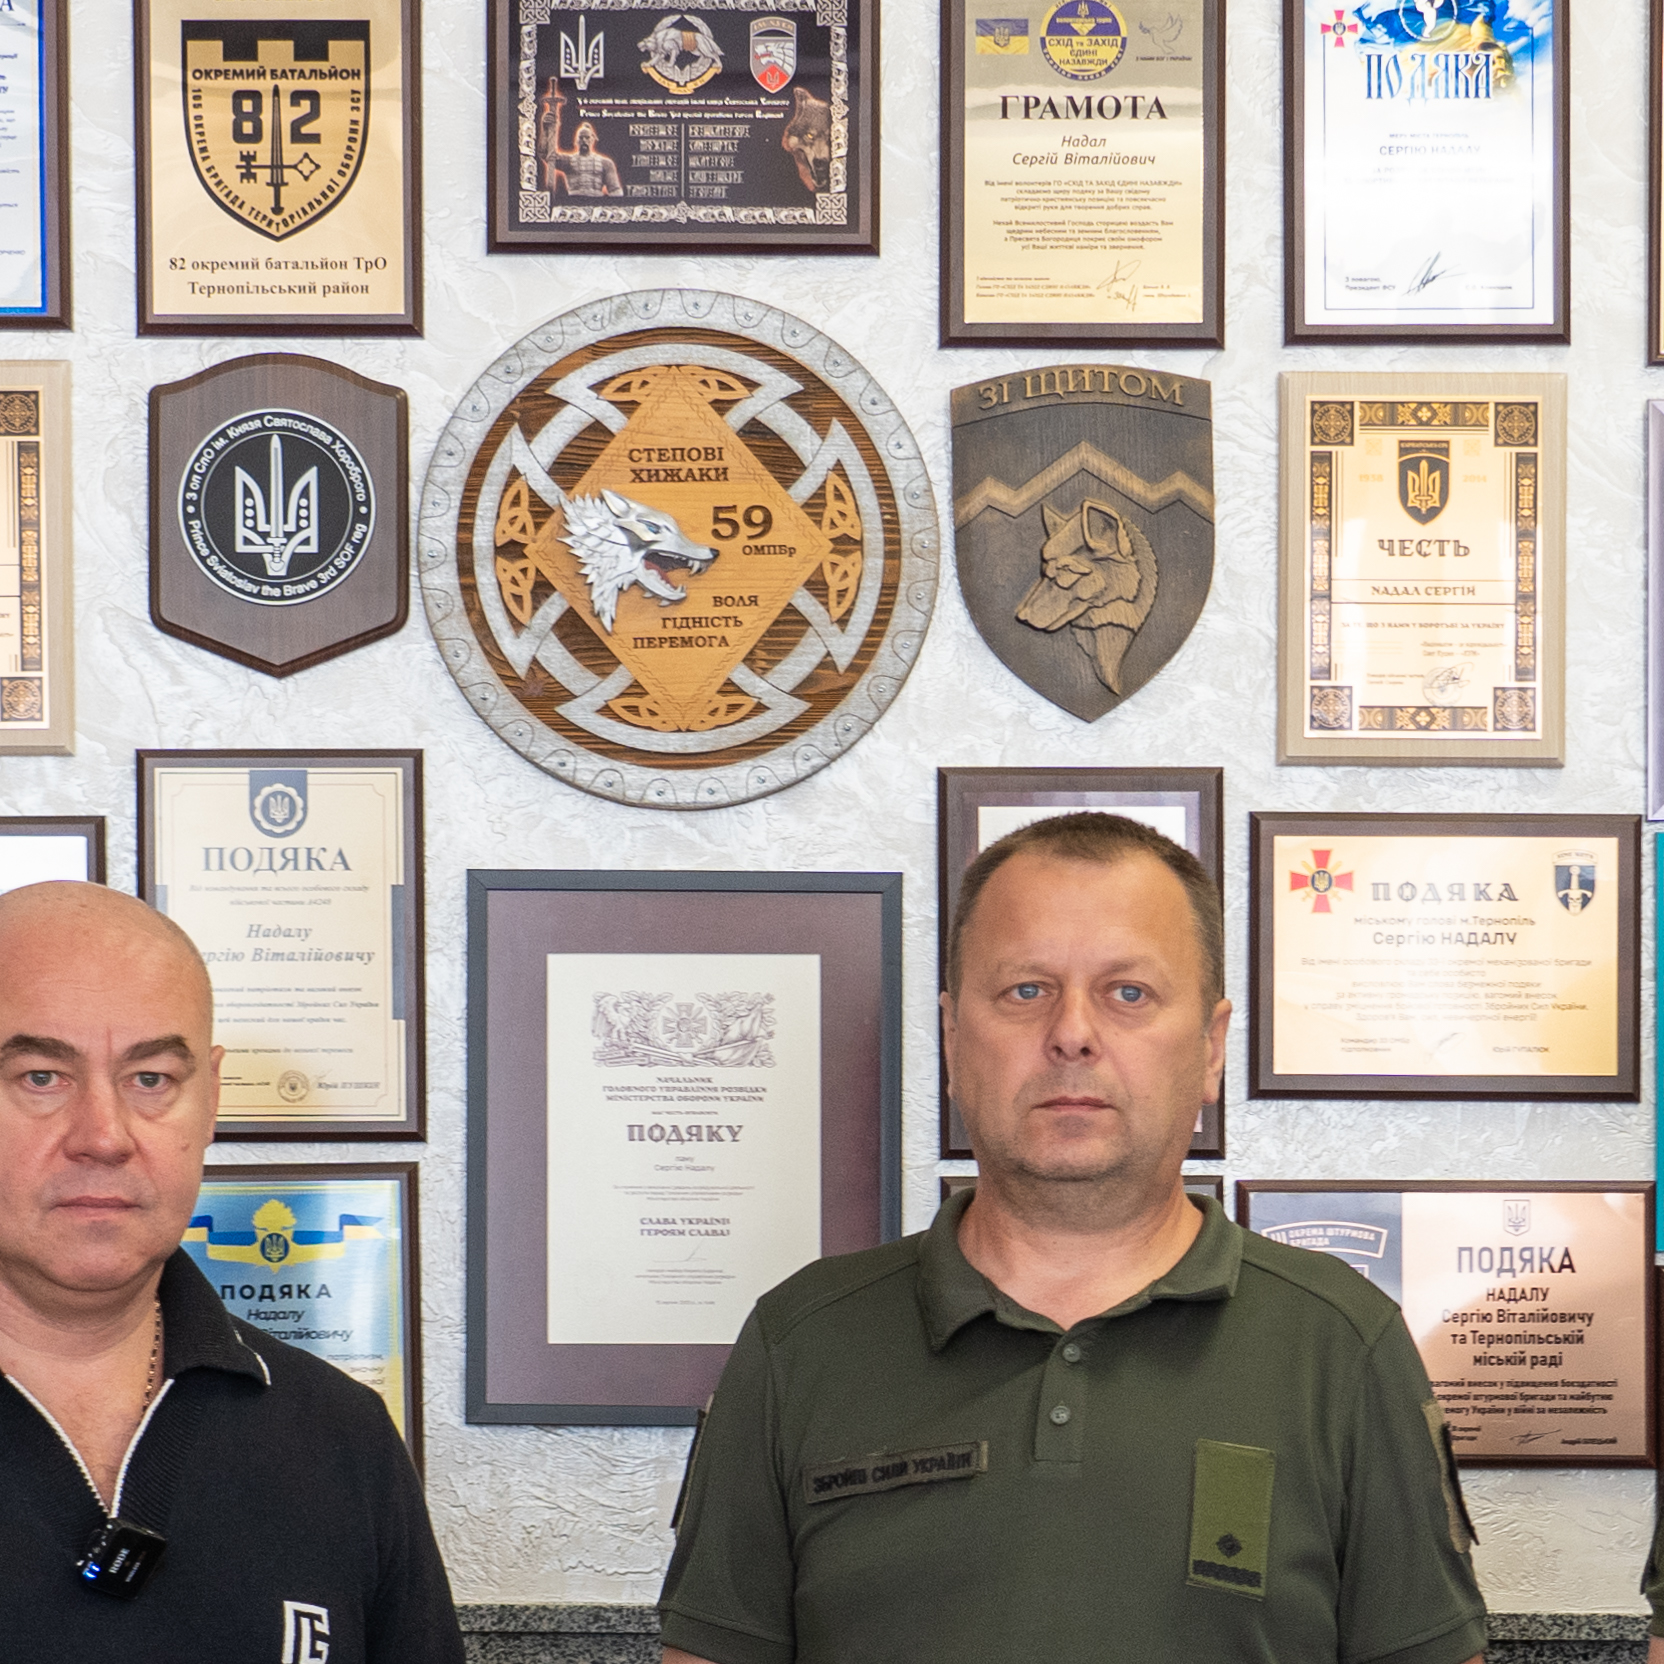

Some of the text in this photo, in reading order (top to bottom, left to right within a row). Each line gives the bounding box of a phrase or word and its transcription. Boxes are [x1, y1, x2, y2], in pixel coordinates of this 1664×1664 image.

[192, 66, 360, 81] ОКРЕМИЙ БАТАЛЬЙОН
[1364, 51, 1494, 108] ПОДЯКА
[1000, 96, 1167, 122] ГРАМОТА
[1061, 135, 1107, 150] Надал
[1013, 150, 1156, 170] Сергій Віталійович
[170, 256, 387, 274] 82 окремий батальйон ТрО
[188, 281, 370, 298] Тернопільський район
[977, 376, 1185, 409] ЗІ ЩИТОМ
[628, 447, 724, 463] СТЕПОВІ
[186, 492, 197, 500] 3
[331, 440, 366, 501] Хороброго
[630, 467, 729, 483] ХИЖАКИ
[711, 505, 773, 540] 59
[743, 544, 796, 560] ОМПБр
[1378, 537, 1470, 559] ЧЕСТЬ
[189, 519, 367, 596] Prince Sviatoslav the Brave 3rd SOF reg
[713, 594, 759, 609] ВОЛЯ
[661, 615, 743, 630] ГІДНІСТЬ
[633, 635, 729, 649] ПЕРЕМОГА
[202, 847, 352, 873] ПОДЯКА
[1371, 882, 1519, 903] ПОДЯКА
[246, 923, 312, 942] Надалу
[1374, 930, 1517, 948] Сергію НАДАЛУ
[627, 1124, 744, 1145] ПОДЯКУ
[1458, 1246, 1575, 1276] ПОДЯКА
[1486, 1287, 1549, 1303] НАДАЛУ
[1443, 1307, 1593, 1327] Сергію Віталійовичу
[1451, 1329, 1584, 1347] та Тернопільській
[1473, 1352, 1563, 1369] міській раді
